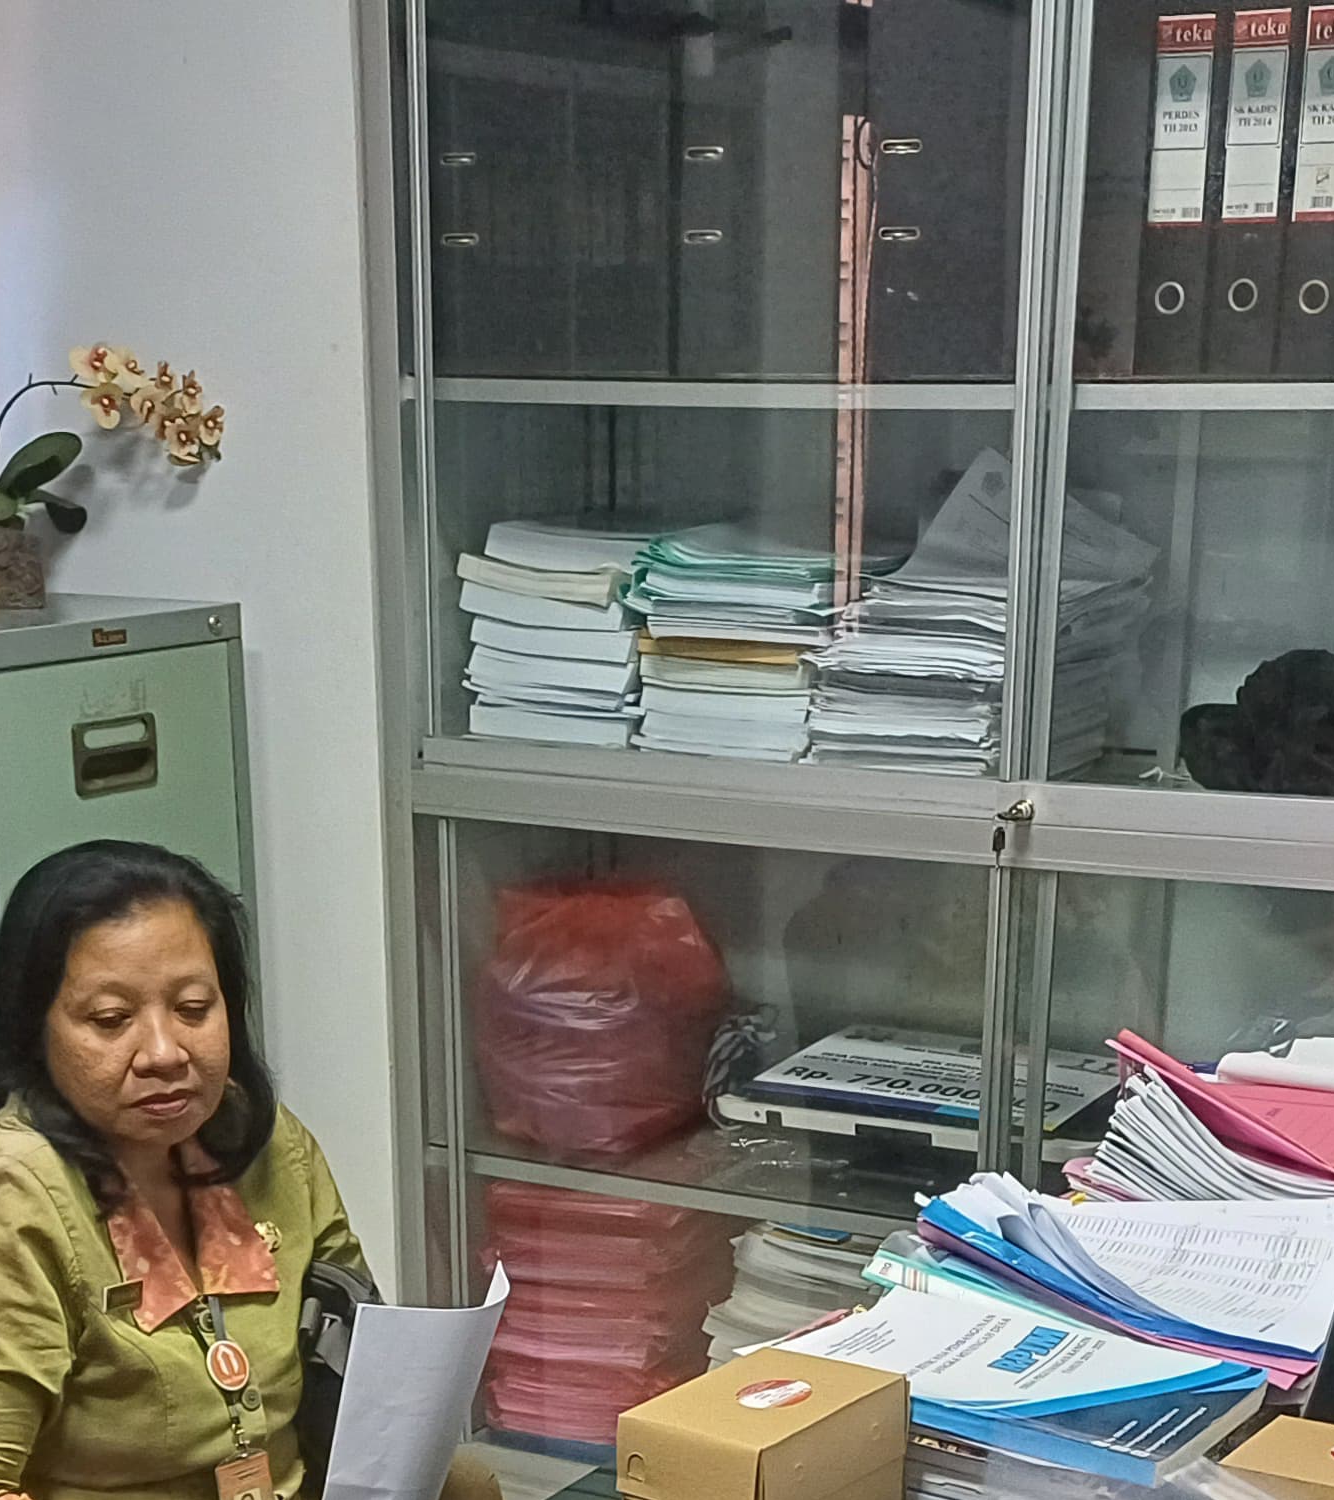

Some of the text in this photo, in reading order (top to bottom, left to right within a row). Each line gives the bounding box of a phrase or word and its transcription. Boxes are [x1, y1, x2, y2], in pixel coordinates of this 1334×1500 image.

[1175, 26, 1213, 42] teka
[1251, 17, 1287, 38] teka
[783, 1066, 834, 1081] Rp.
[987, 1325, 1070, 1374] RPJM
